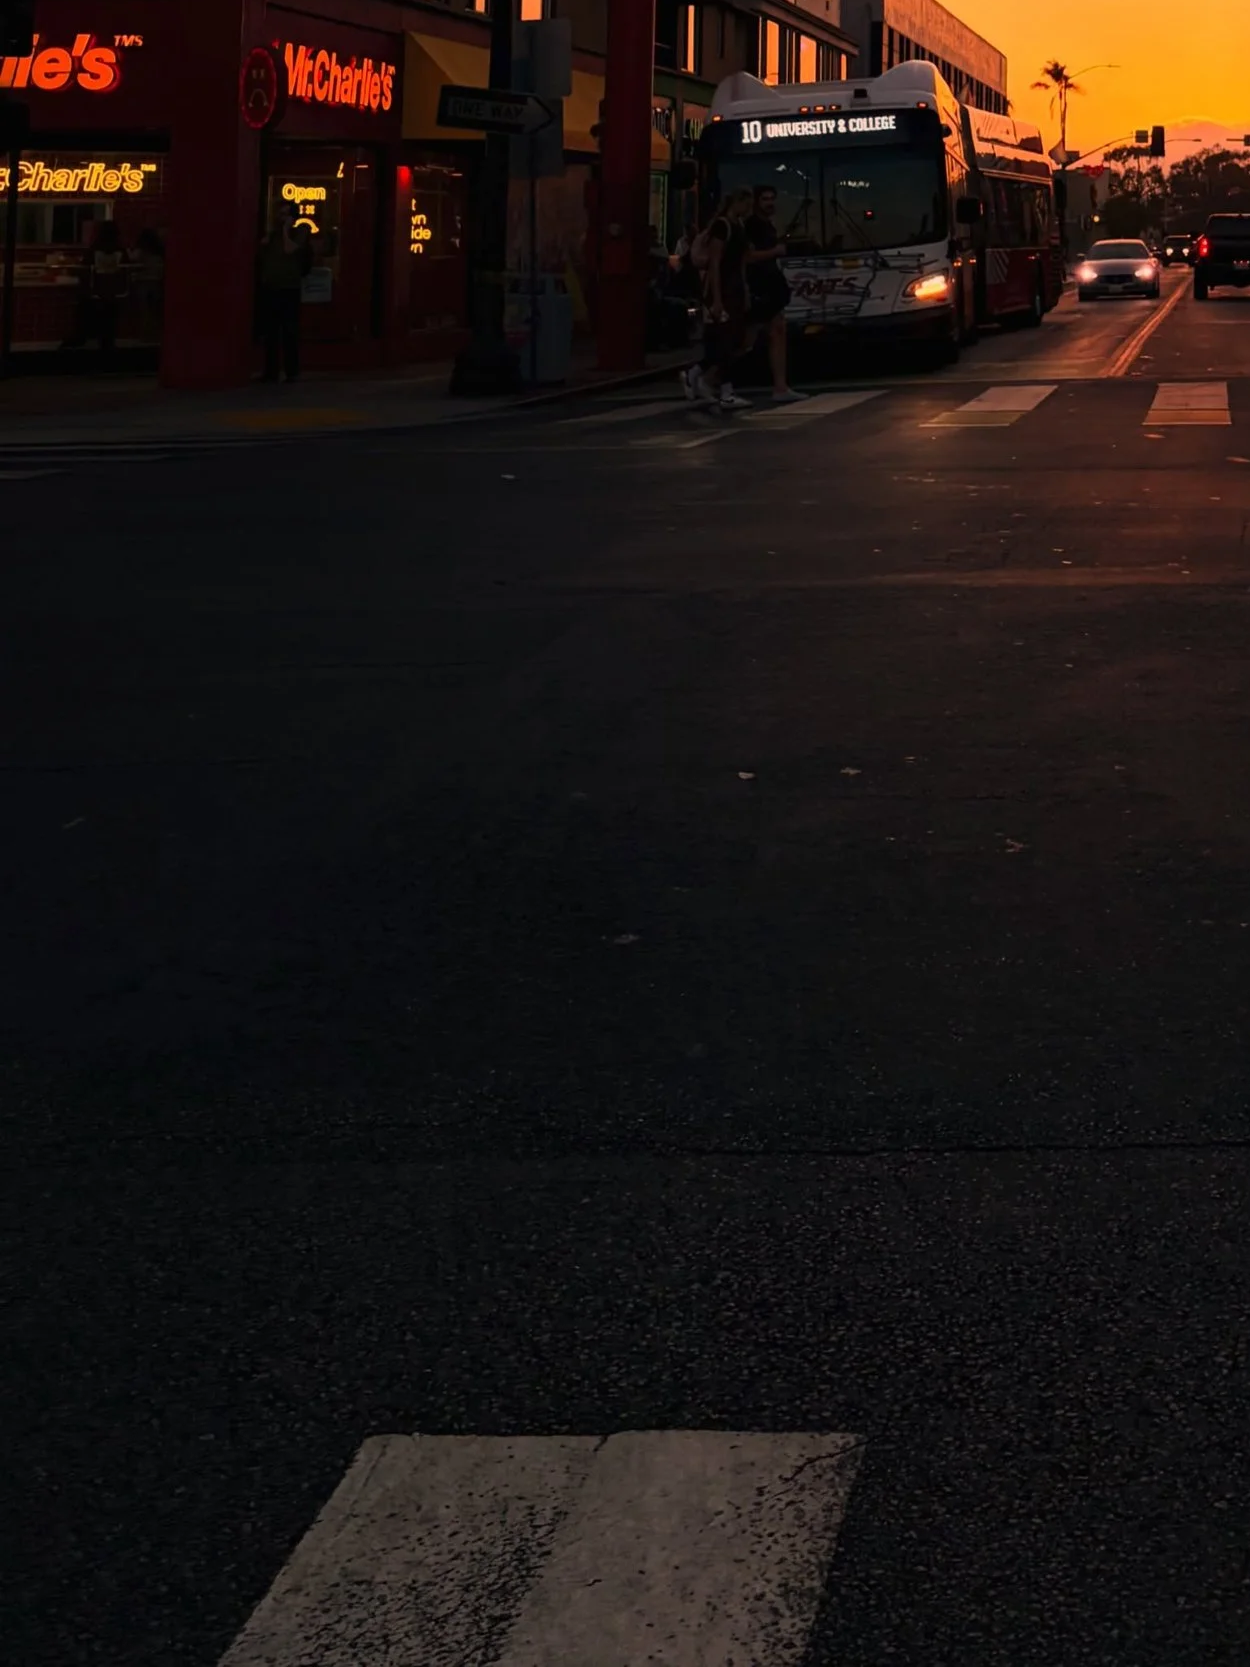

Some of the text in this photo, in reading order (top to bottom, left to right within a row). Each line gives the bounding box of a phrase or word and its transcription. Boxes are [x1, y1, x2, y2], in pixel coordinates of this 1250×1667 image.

[741, 115, 897, 144] 10 UNIVERSITY & COLLEGE
[282, 183, 326, 204] Open
